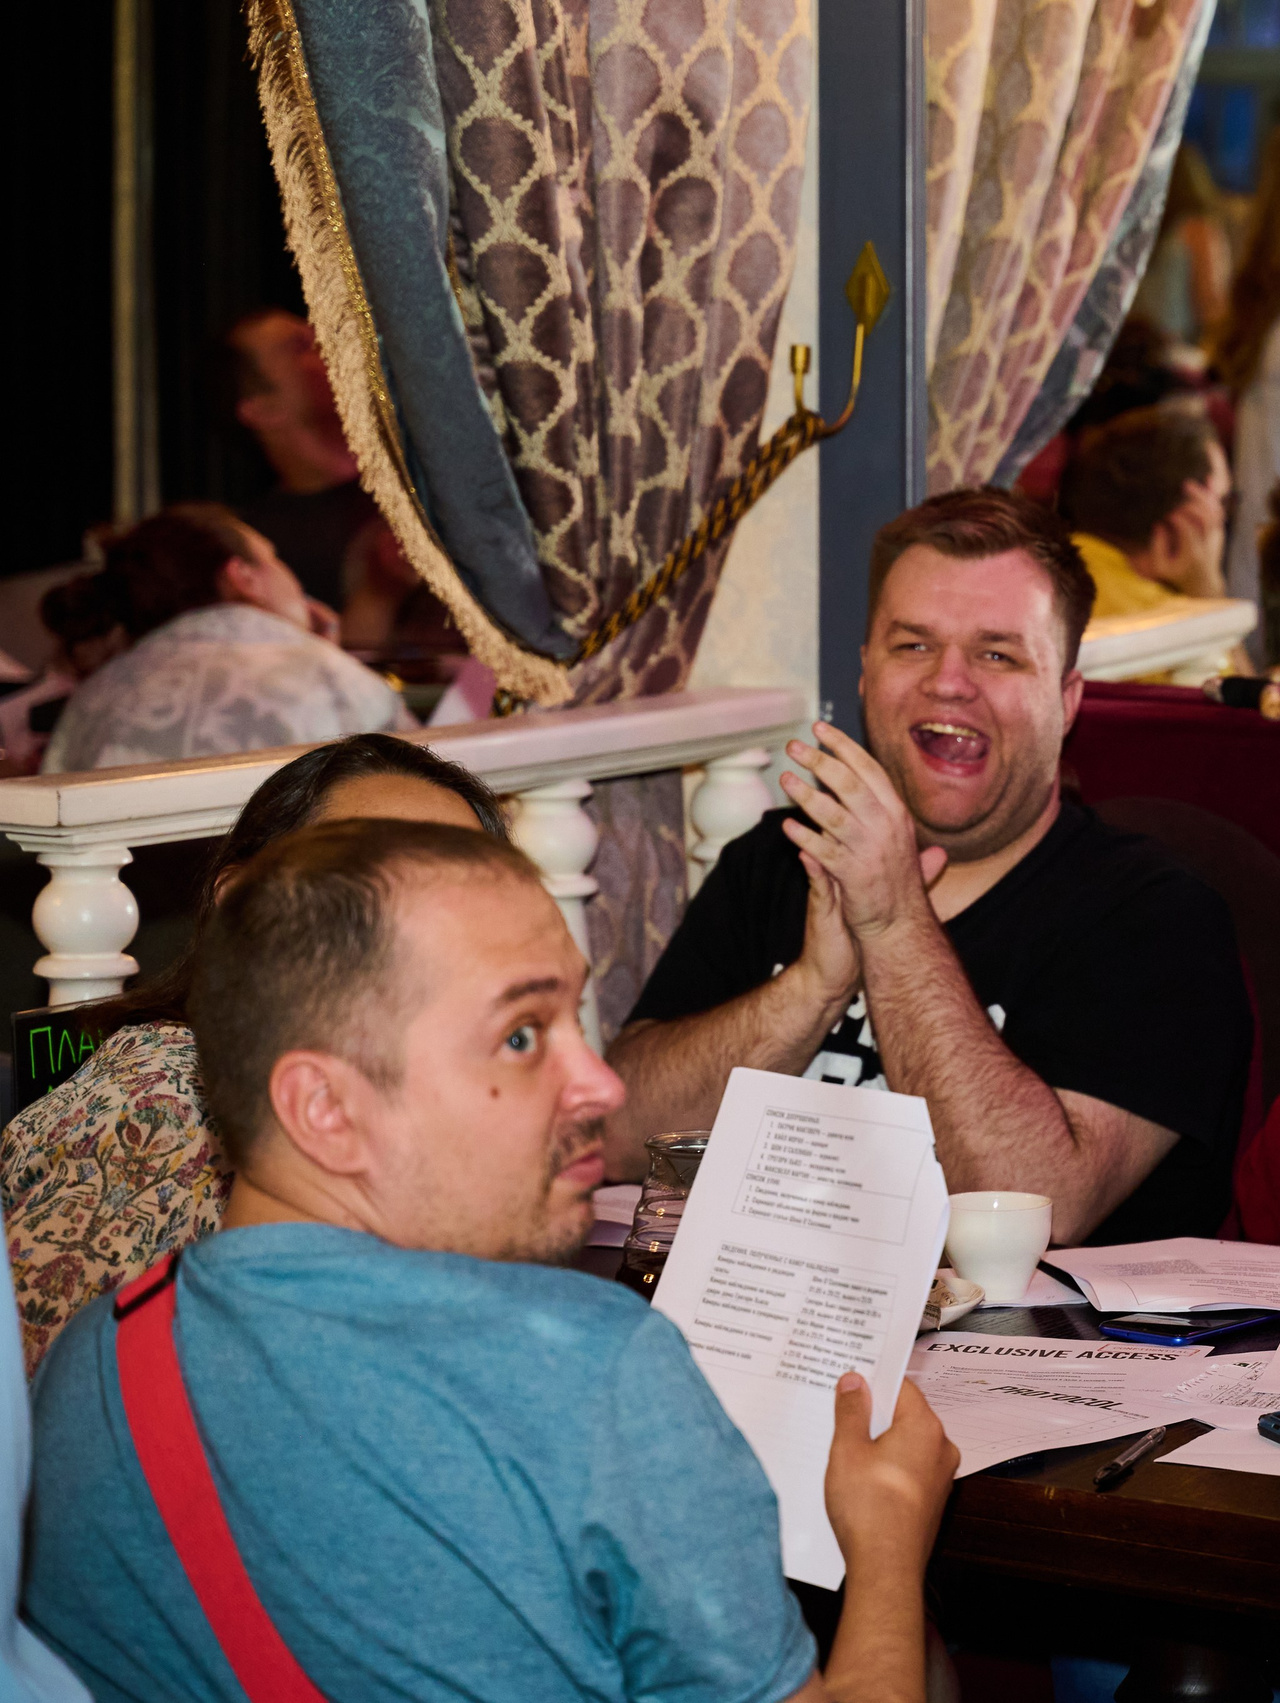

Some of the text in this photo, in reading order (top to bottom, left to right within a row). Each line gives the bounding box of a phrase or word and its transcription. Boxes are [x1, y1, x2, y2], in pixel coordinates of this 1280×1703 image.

[30, 1025, 103, 1079] ПЛА
[927, 1343, 1180, 1361] EXCLUSIVE ACCESS
[988, 1385, 1125, 1411] PROTOCOL
